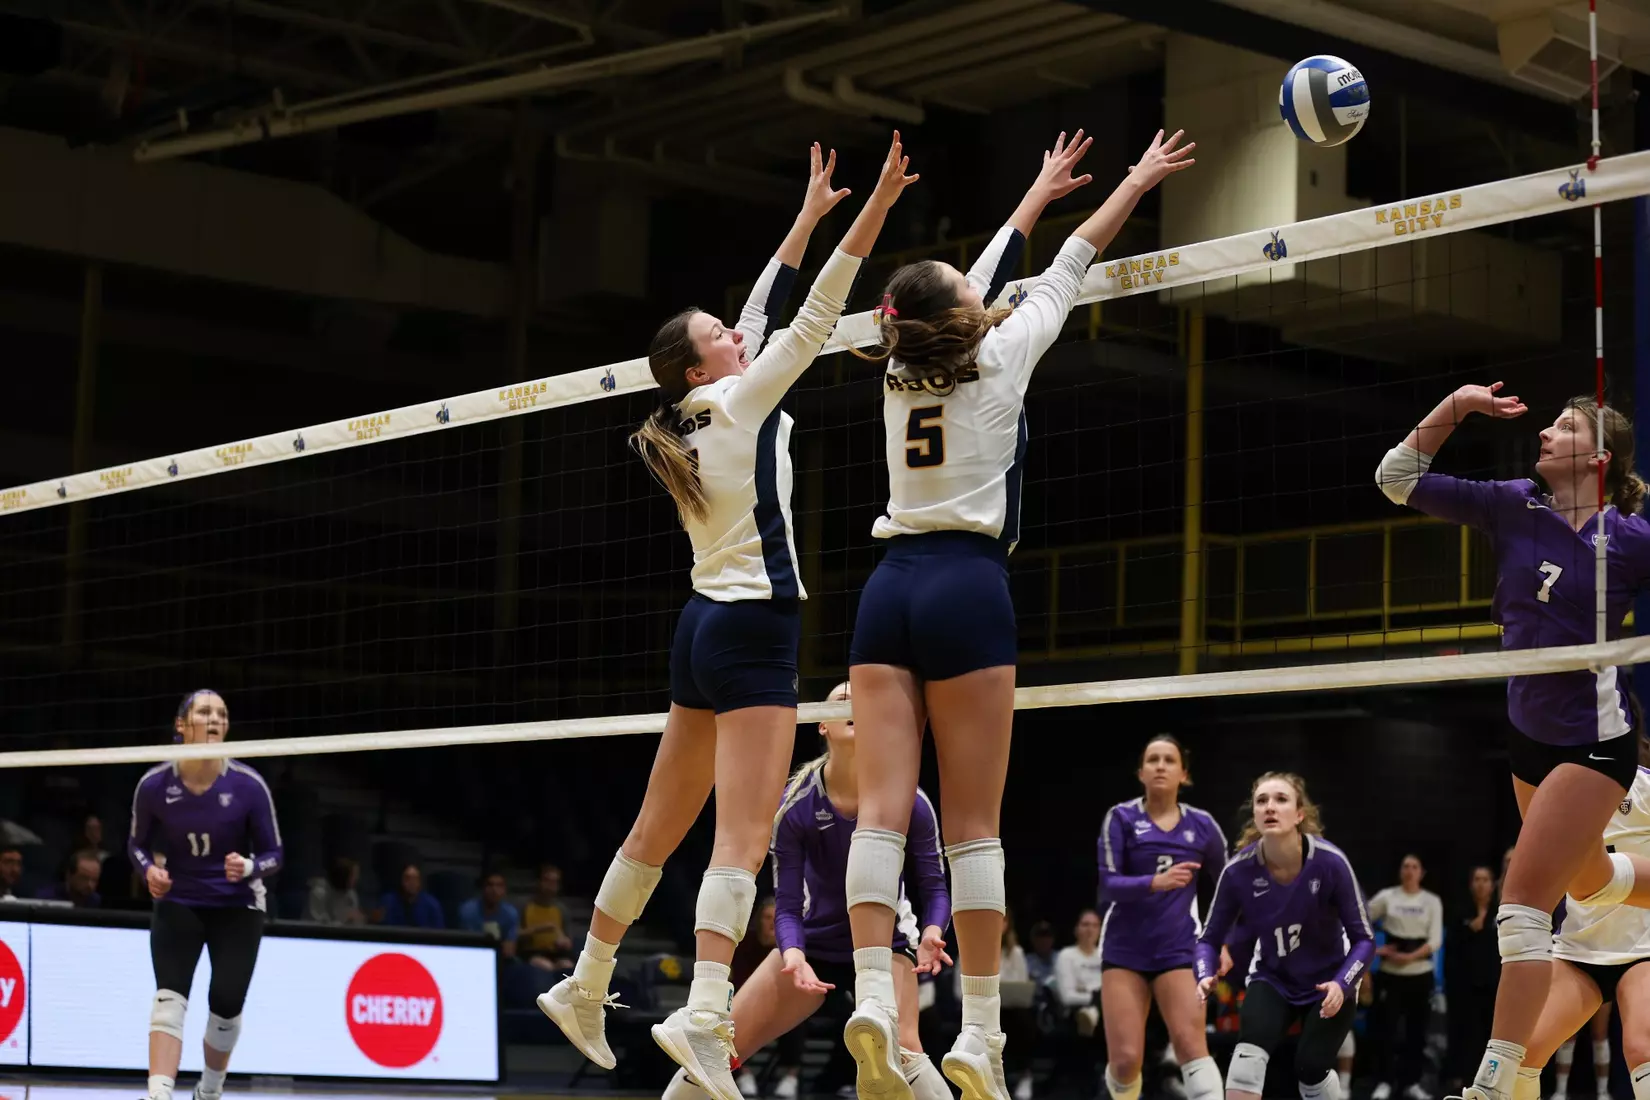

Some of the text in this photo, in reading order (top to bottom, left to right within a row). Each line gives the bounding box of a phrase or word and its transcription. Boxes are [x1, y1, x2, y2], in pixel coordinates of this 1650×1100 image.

[1375, 194, 1462, 224] KANSAS
[1395, 213, 1444, 235] CITY
[1105, 252, 1180, 278] KANSAS
[1121, 269, 1164, 289] CITY
[499, 381, 548, 401] KANSAS
[509, 396, 537, 411] CITY
[905, 404, 946, 470] 5
[1536, 560, 1563, 603] 7
[187, 832, 210, 857] 11
[1274, 923, 1303, 958] 12
[352, 993, 437, 1027] CHERRY
